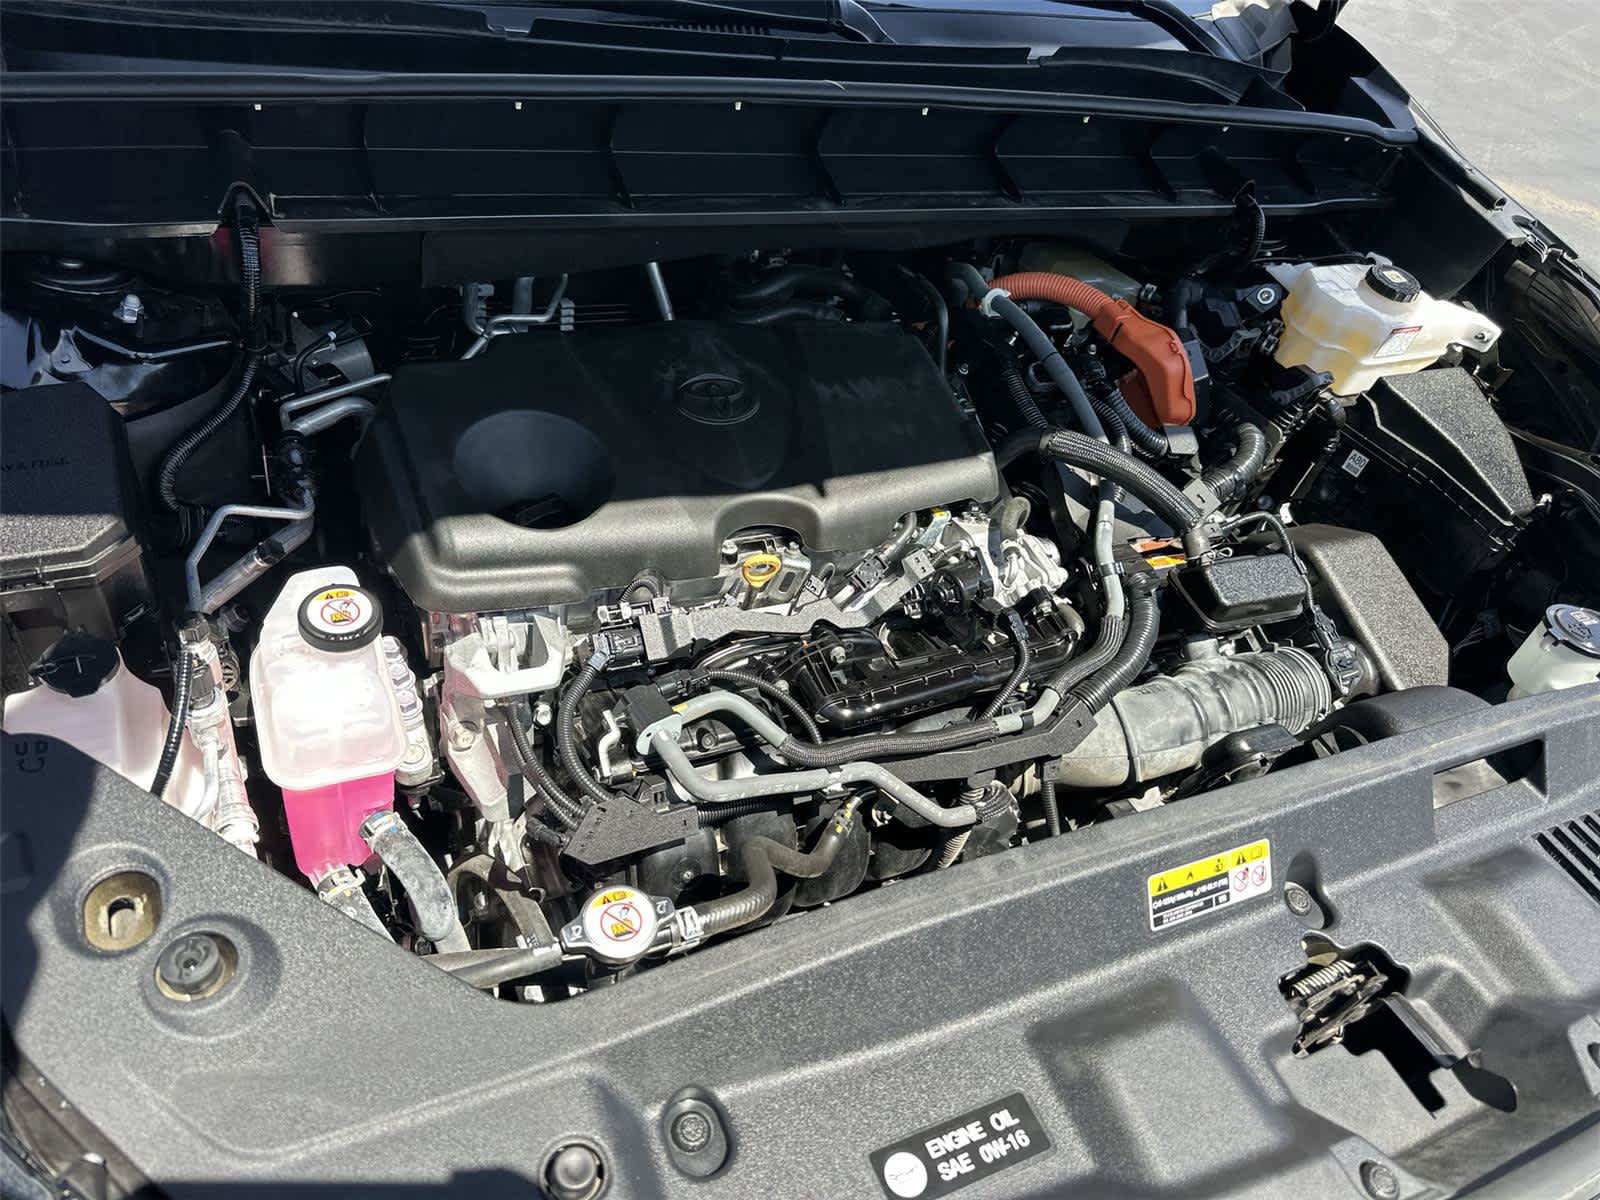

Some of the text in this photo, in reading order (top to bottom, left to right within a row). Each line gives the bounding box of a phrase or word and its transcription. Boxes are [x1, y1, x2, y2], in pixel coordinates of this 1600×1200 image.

[924, 1109, 1020, 1160] ENGINE OIL
[937, 1152, 976, 1181] SAE
[978, 1129, 1031, 1163] 0W-16
